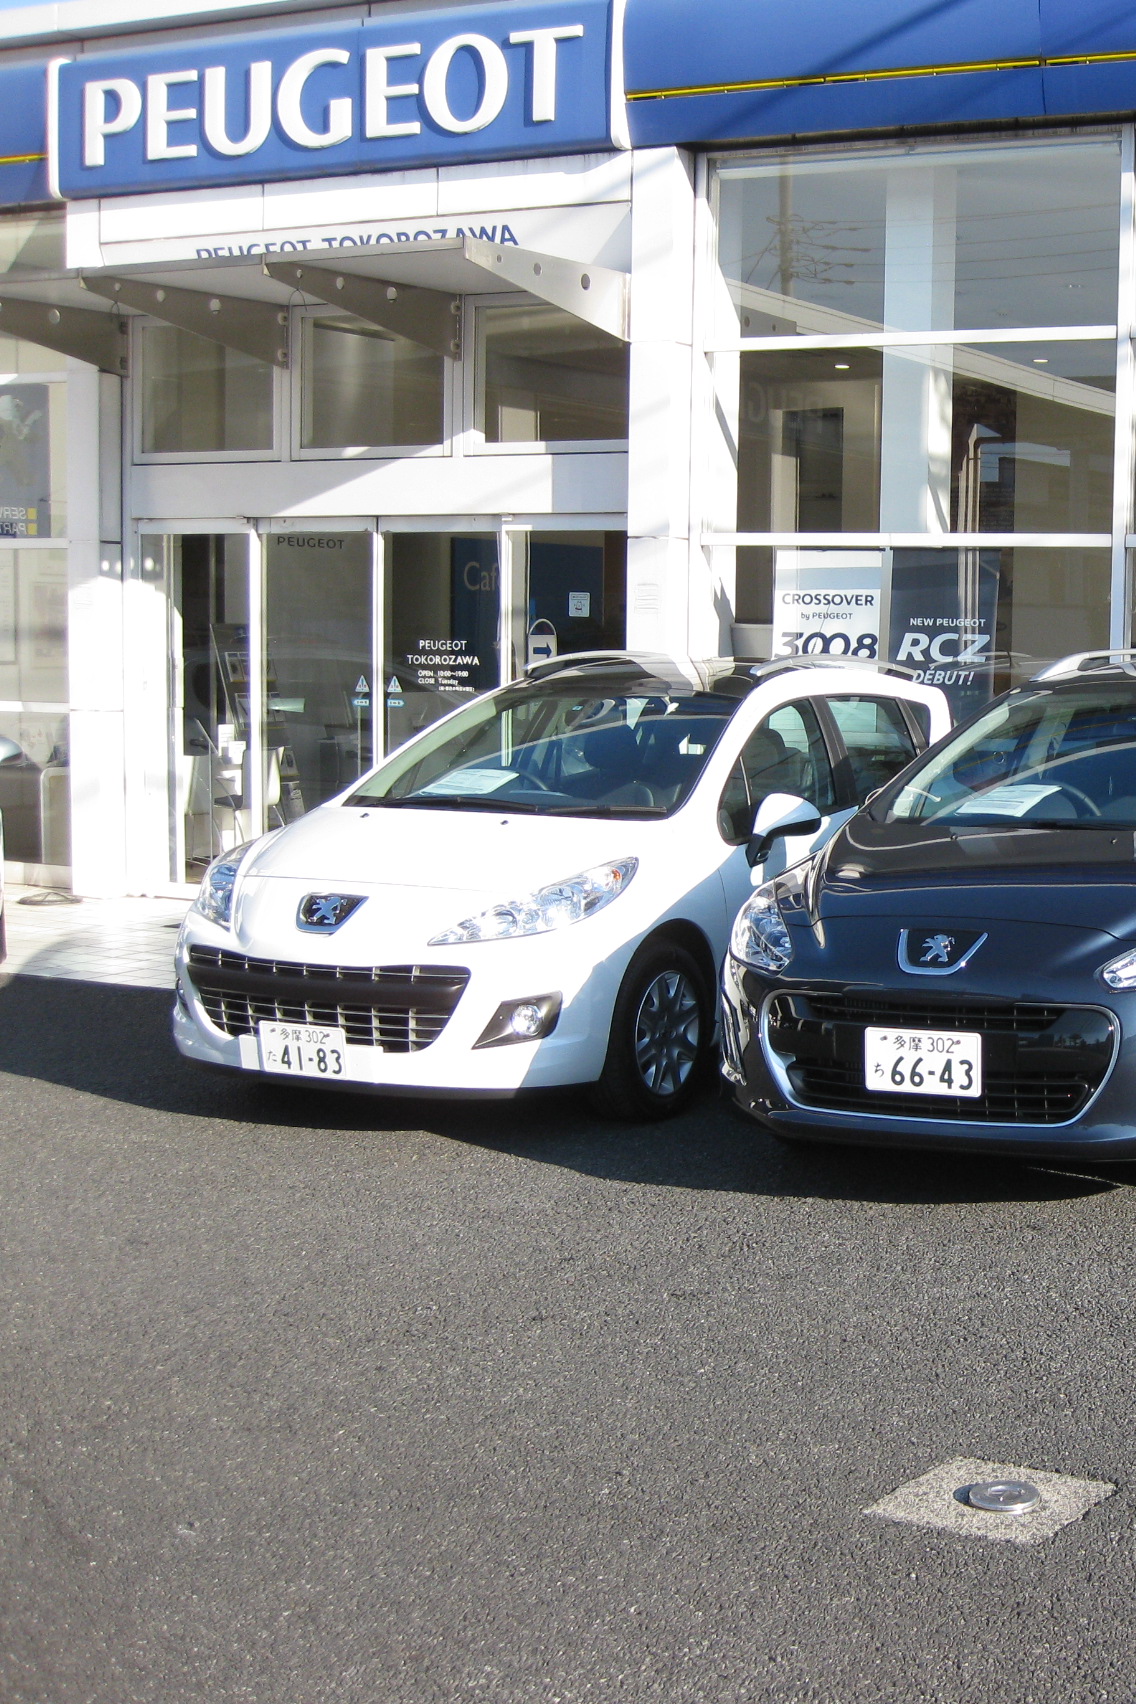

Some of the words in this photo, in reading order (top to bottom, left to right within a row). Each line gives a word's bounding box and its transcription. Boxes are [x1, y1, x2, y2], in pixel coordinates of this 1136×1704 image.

[82, 24, 584, 168] PEUGEOT
[277, 535, 345, 550] PEUGEOT
[463, 561, 500, 591] Caf
[782, 593, 875, 607] CROSSOVER
[800, 612, 811, 621] by
[812, 612, 853, 621] PEUGEOT
[909, 617, 933, 627] NEW
[936, 618, 986, 628] PEUGEOT
[419, 640, 468, 651] PEUGEOT
[774, 631, 879, 659] 3008
[896, 632, 991, 663] RCZ
[407, 654, 480, 666] TOKOROZAWA
[912, 666, 975, 686] DÉBUT!
[280, 1027, 302, 1042] 多摩
[305, 1029, 327, 1045] 302
[893, 1034, 923, 1052] 多摩
[927, 1036, 955, 1054] 302
[267, 1050, 279, 1062] た
[281, 1044, 343, 1075] 41-83
[873, 1062, 885, 1078] ち
[890, 1055, 974, 1091] 66-43
